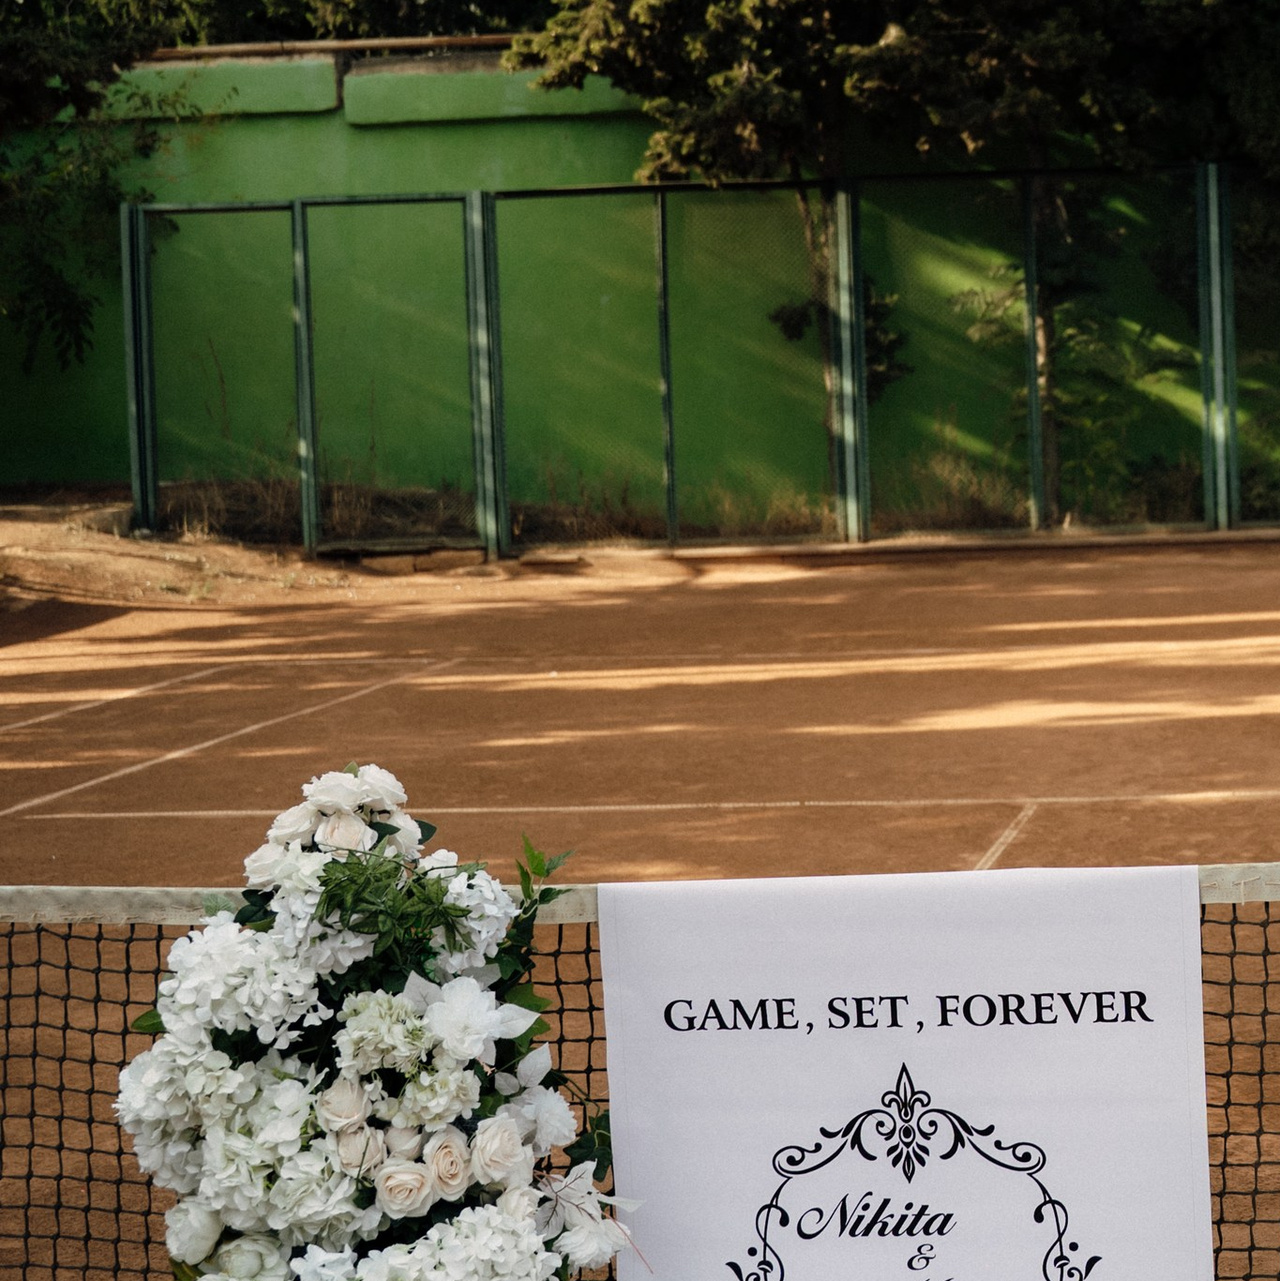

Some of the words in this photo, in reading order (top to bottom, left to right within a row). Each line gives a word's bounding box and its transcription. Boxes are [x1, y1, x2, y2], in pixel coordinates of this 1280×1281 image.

[663, 997, 814, 1035] GAME,
[827, 995, 924, 1034] SET,
[936, 990, 1155, 1027] FOREVER
[796, 1190, 958, 1240] Nikita
[906, 1243, 937, 1271] &
